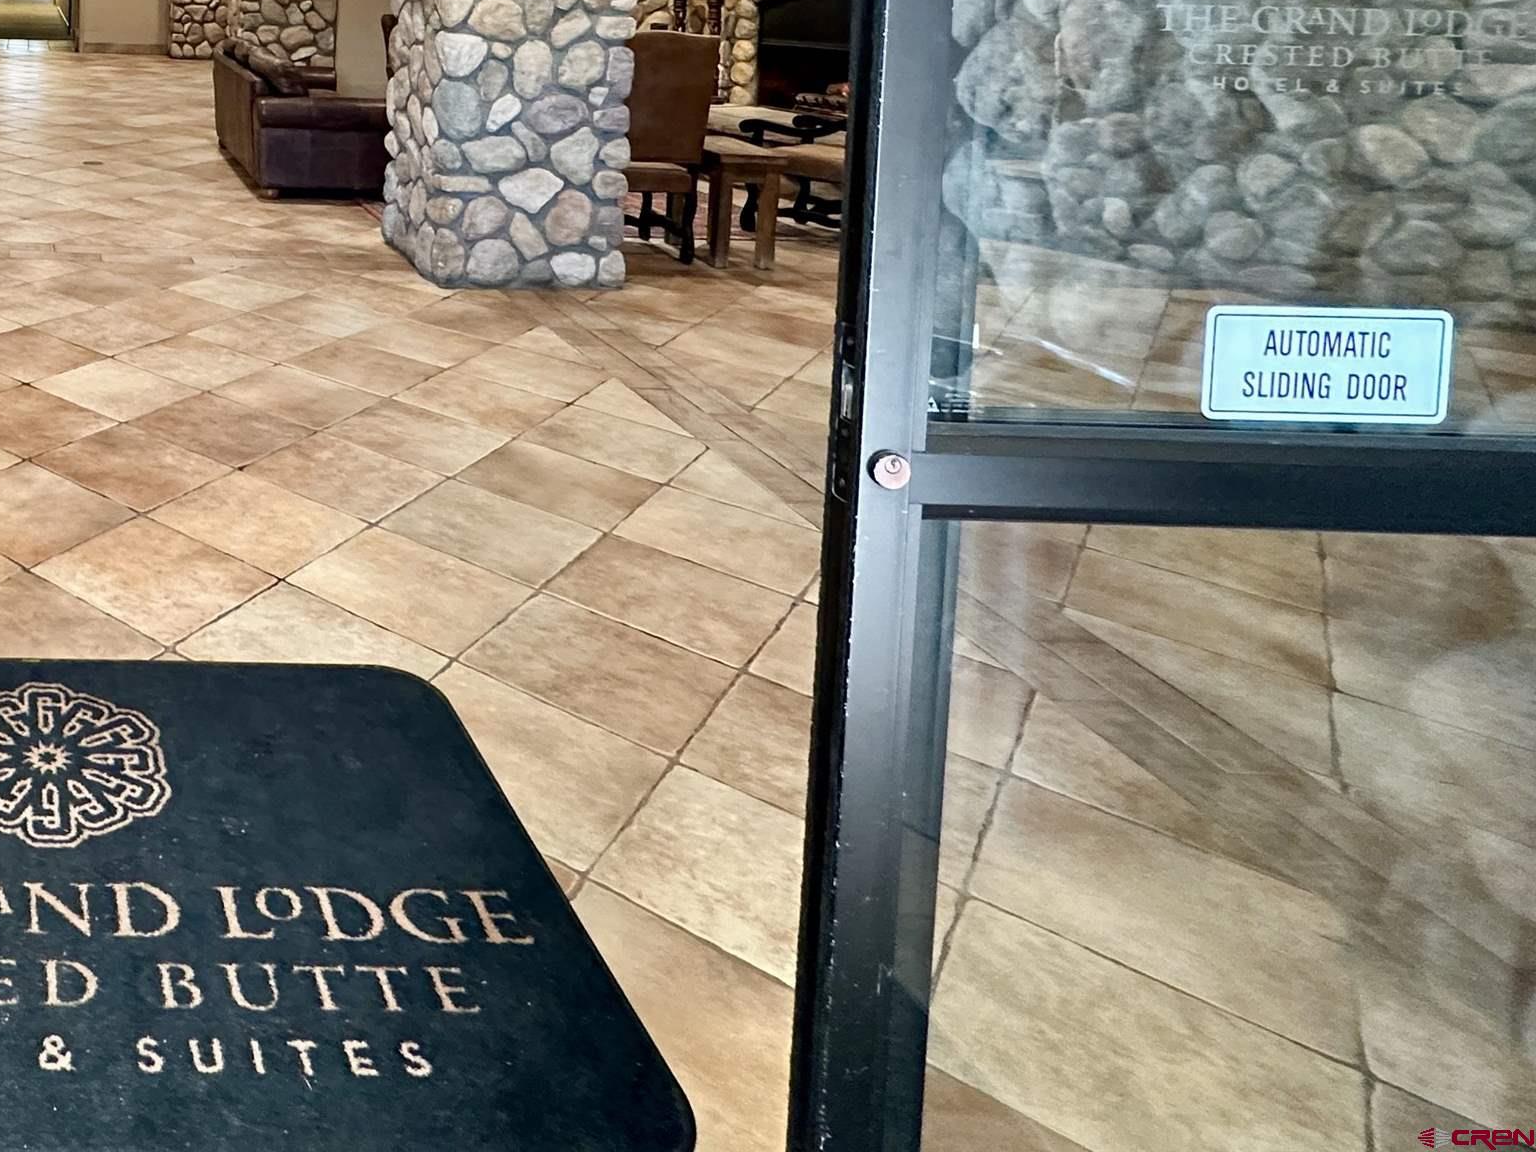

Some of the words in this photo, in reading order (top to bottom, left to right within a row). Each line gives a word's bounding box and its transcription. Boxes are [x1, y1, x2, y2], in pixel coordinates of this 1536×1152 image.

[1156, 3, 1242, 33] THE
[1251, 5, 1391, 37] GRAND
[1404, 7, 1531, 40] LODGE
[1188, 43, 1355, 69] CRESTED
[1214, 75, 1309, 94] HOEL
[1325, 78, 1341, 94] &
[1263, 329, 1392, 359] AUTOMATIC
[1241, 370, 1332, 399] SLIDING
[1346, 373, 1408, 401] DOOR
[212, 884, 536, 945] LODGE
[156, 960, 482, 1014] BUTTE
[37, 1034, 77, 1073] &
[135, 1034, 434, 1078] SUITES
